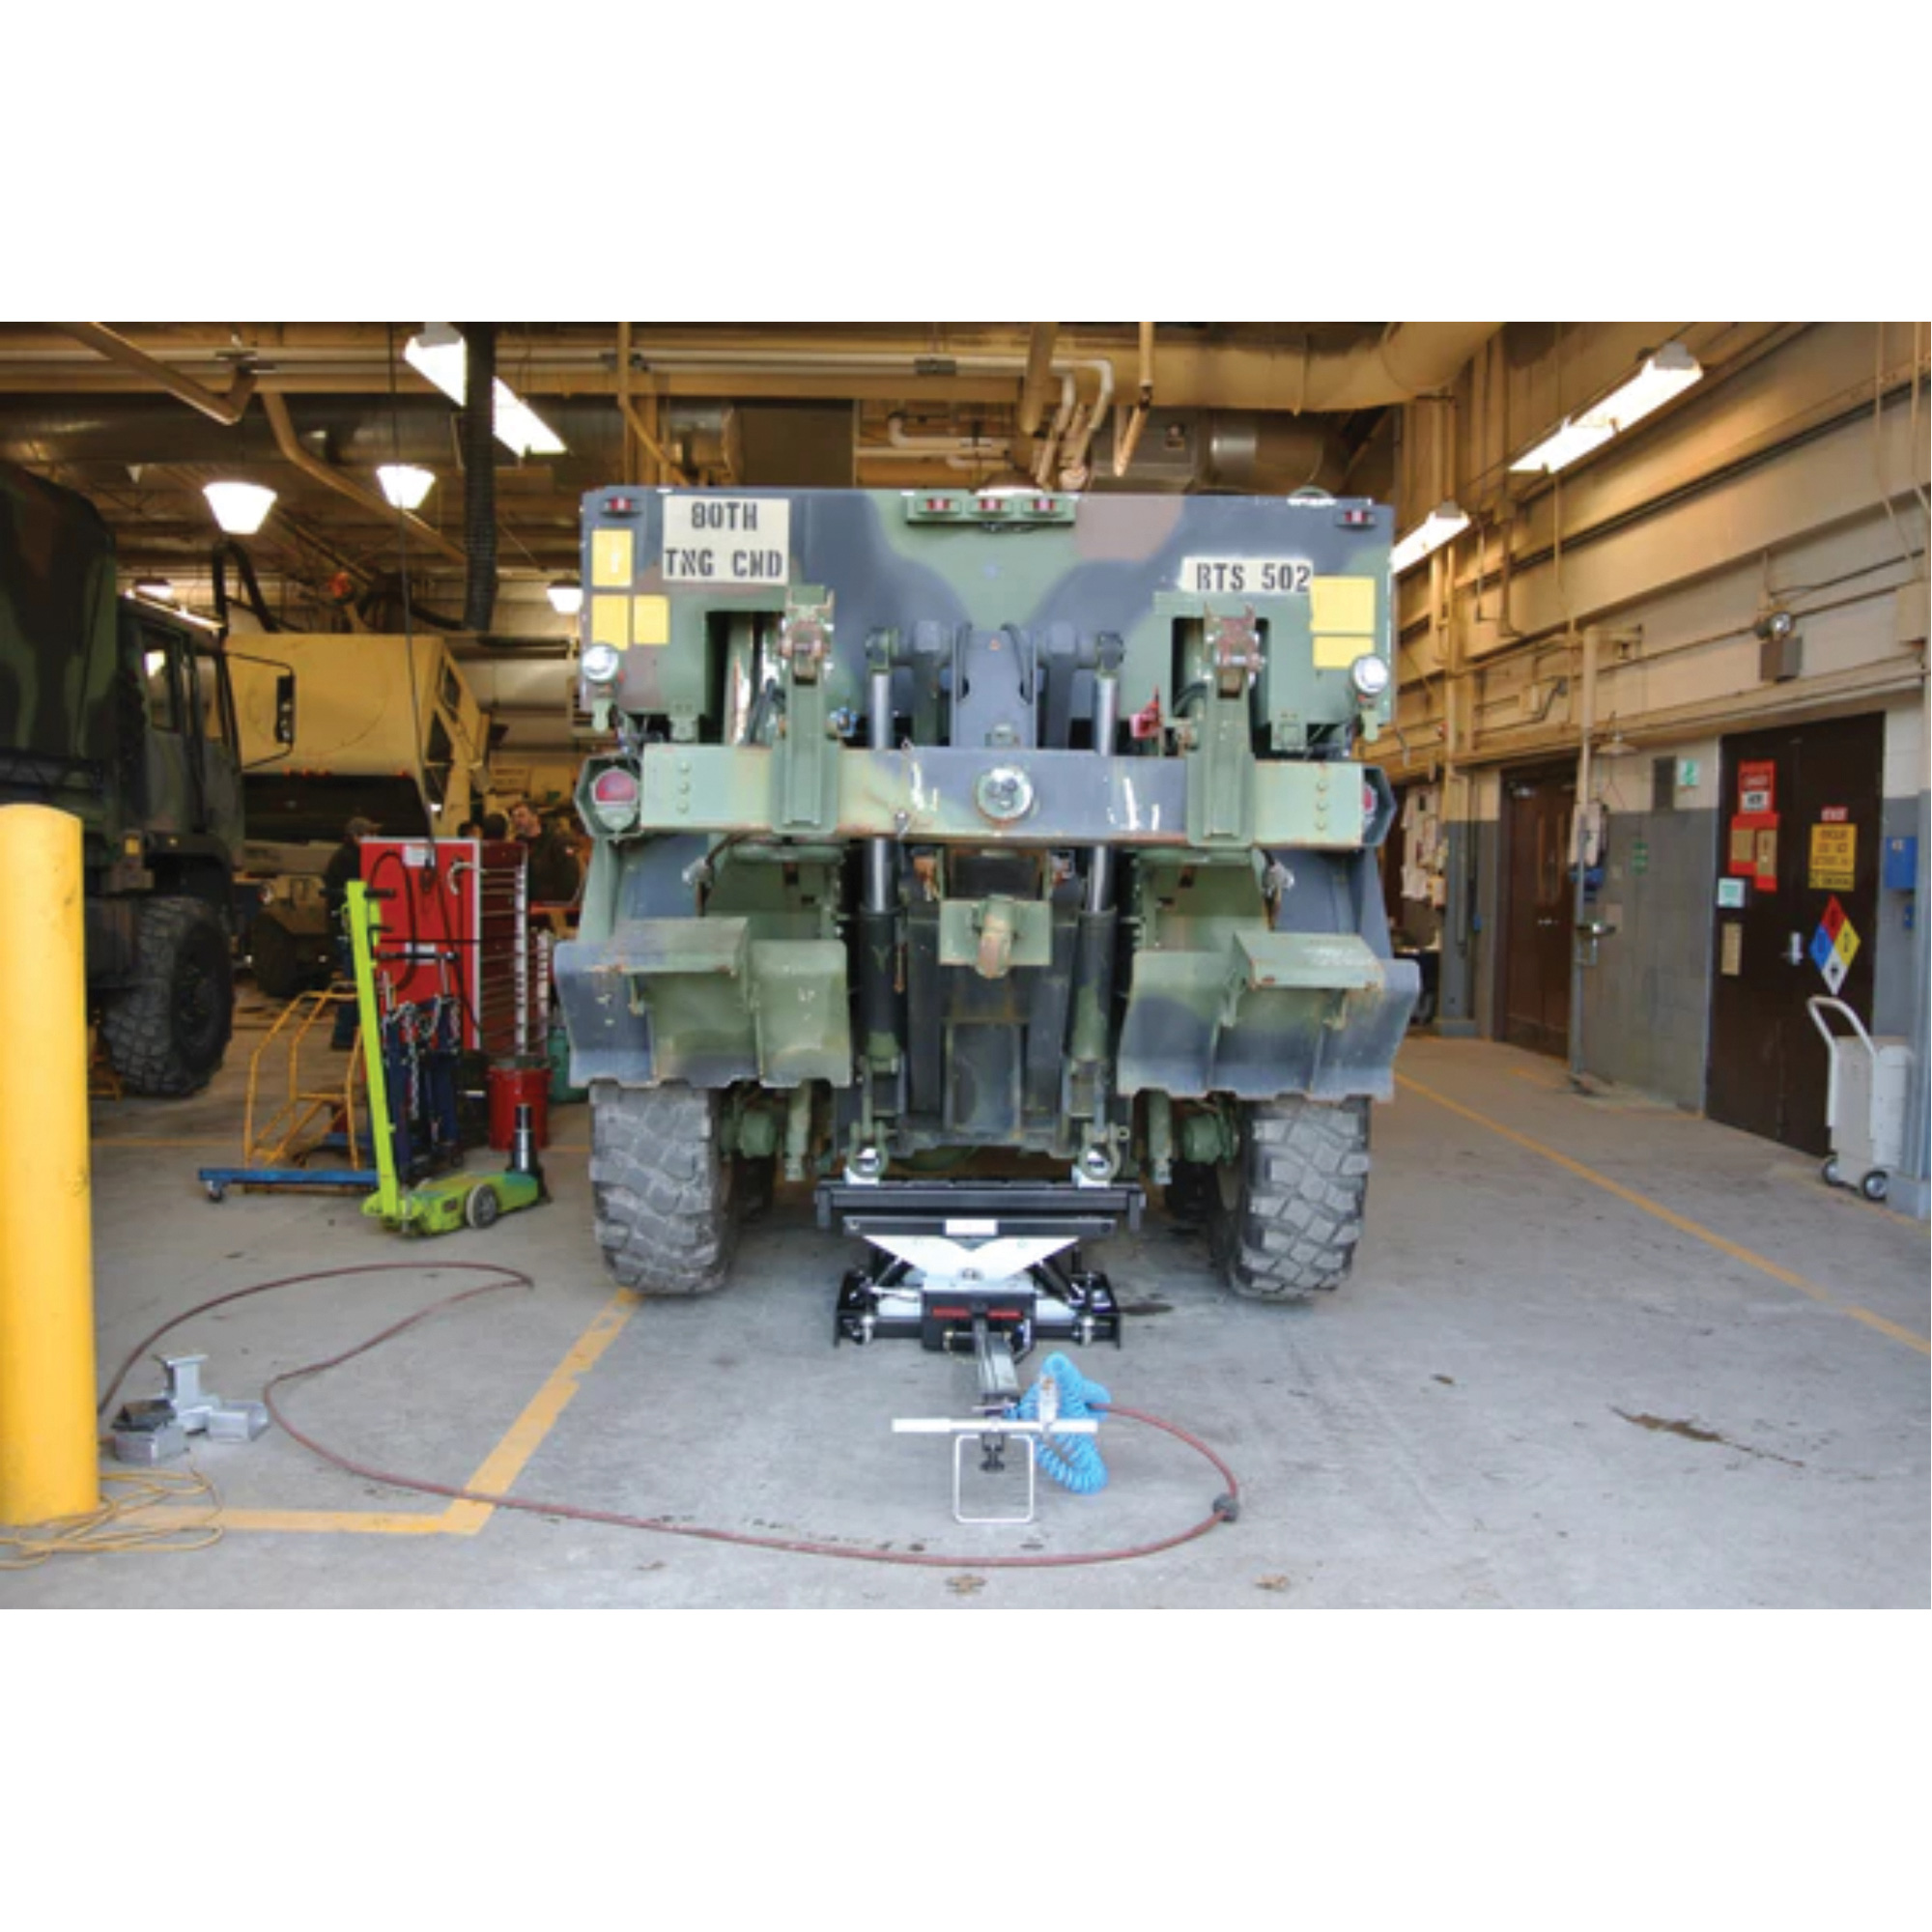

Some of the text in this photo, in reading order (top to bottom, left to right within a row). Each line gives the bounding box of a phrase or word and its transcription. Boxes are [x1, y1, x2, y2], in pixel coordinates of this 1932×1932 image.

[691, 501, 757, 531] 80TH
[664, 548, 783, 578] TNG CMD
[1197, 562, 1311, 592] RTS 502
